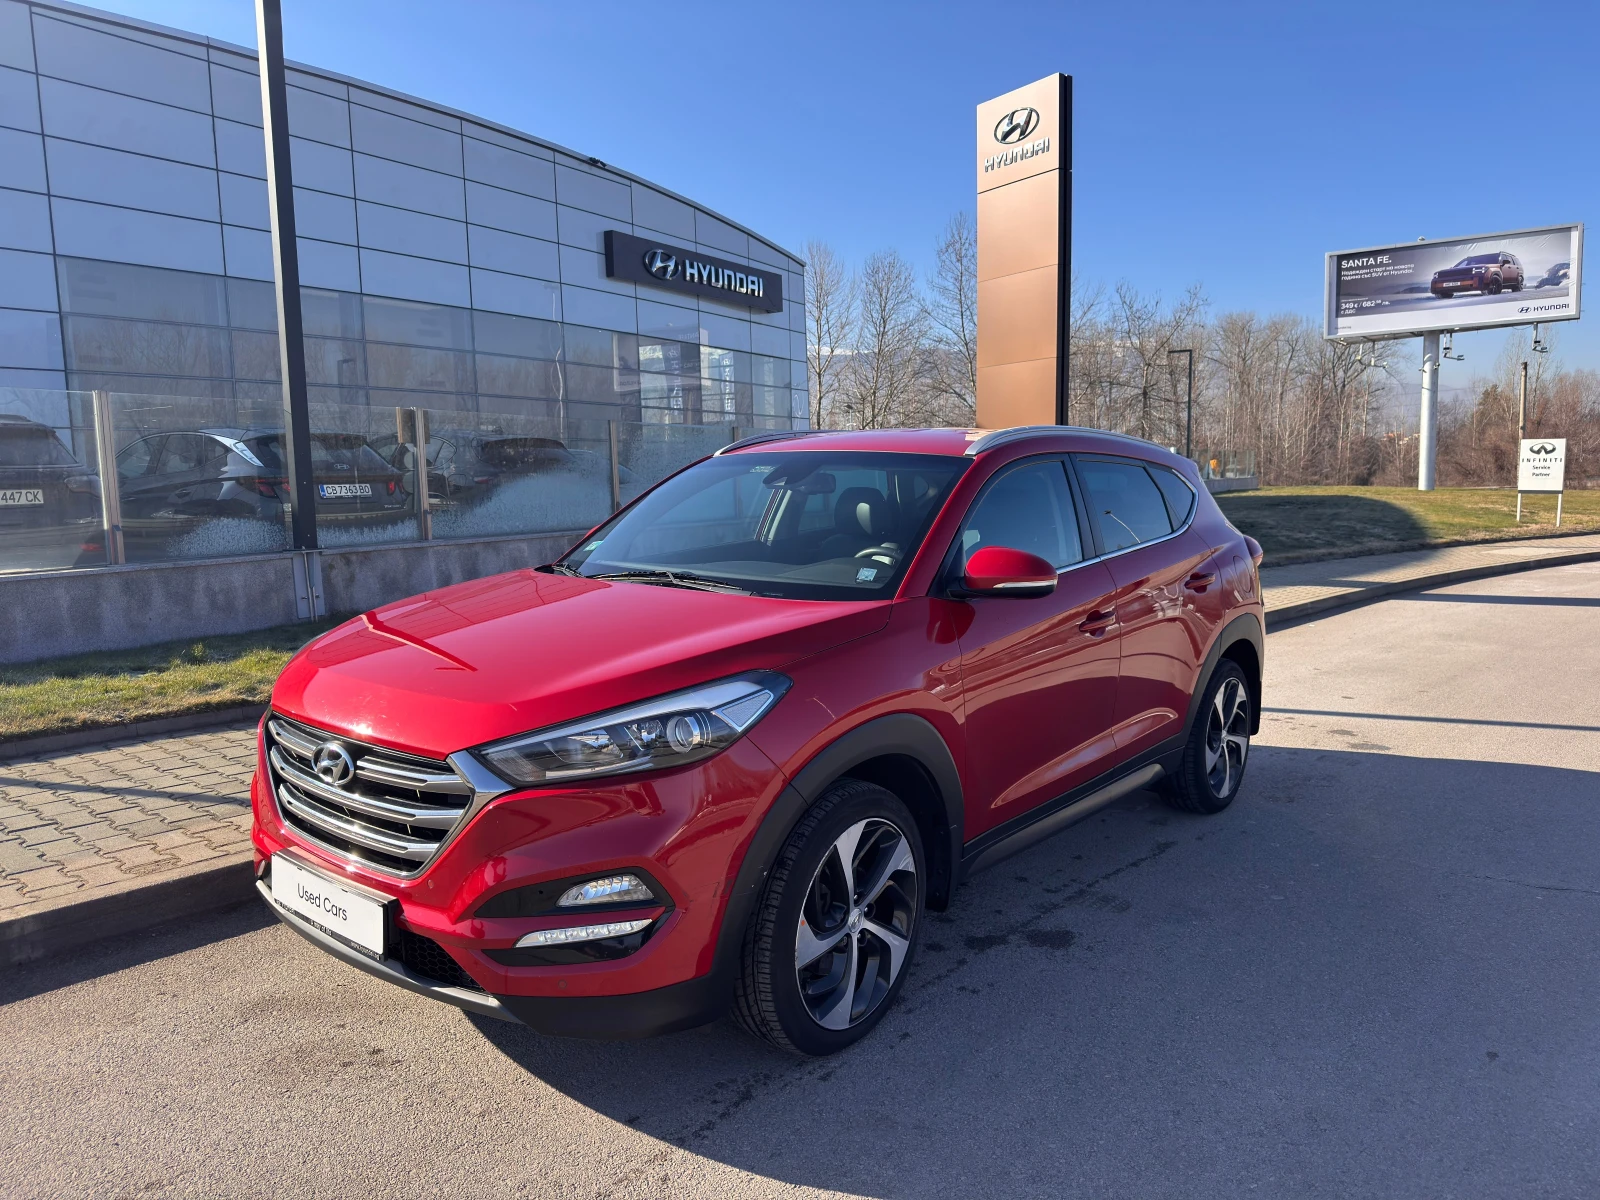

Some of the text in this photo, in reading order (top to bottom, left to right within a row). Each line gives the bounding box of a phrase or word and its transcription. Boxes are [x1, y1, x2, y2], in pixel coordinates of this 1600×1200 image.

[984, 136, 1050, 173] HYUNDAI
[1341, 255, 1392, 268] SANTA FE.
[685, 259, 764, 298] HYUNDAI
[1533, 303, 1570, 312] HYUNDAI
[0, 490, 41, 503] 447 CK
[297, 883, 321, 908] Used
[323, 897, 348, 921] Cars
